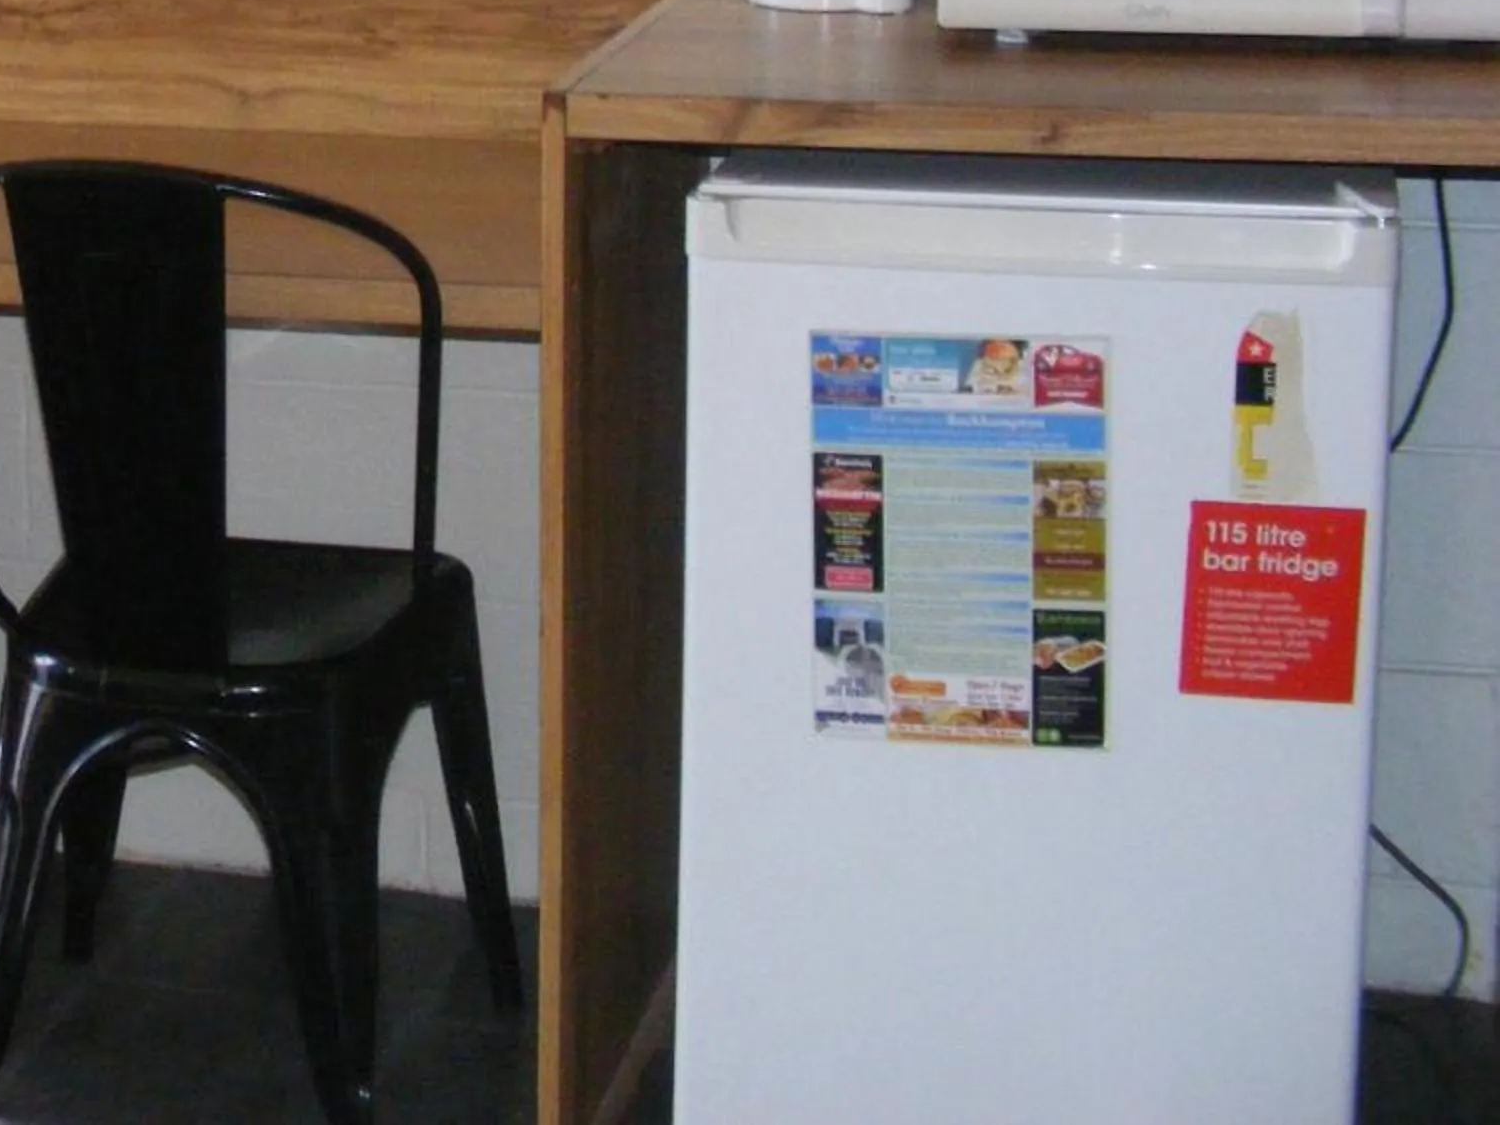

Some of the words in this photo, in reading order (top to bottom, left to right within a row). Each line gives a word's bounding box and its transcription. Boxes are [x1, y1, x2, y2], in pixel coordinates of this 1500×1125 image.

[1205, 520, 1249, 544] 115
[1256, 522, 1306, 548] litre
[1203, 547, 1250, 572] bar
[1258, 550, 1338, 582] fridge
